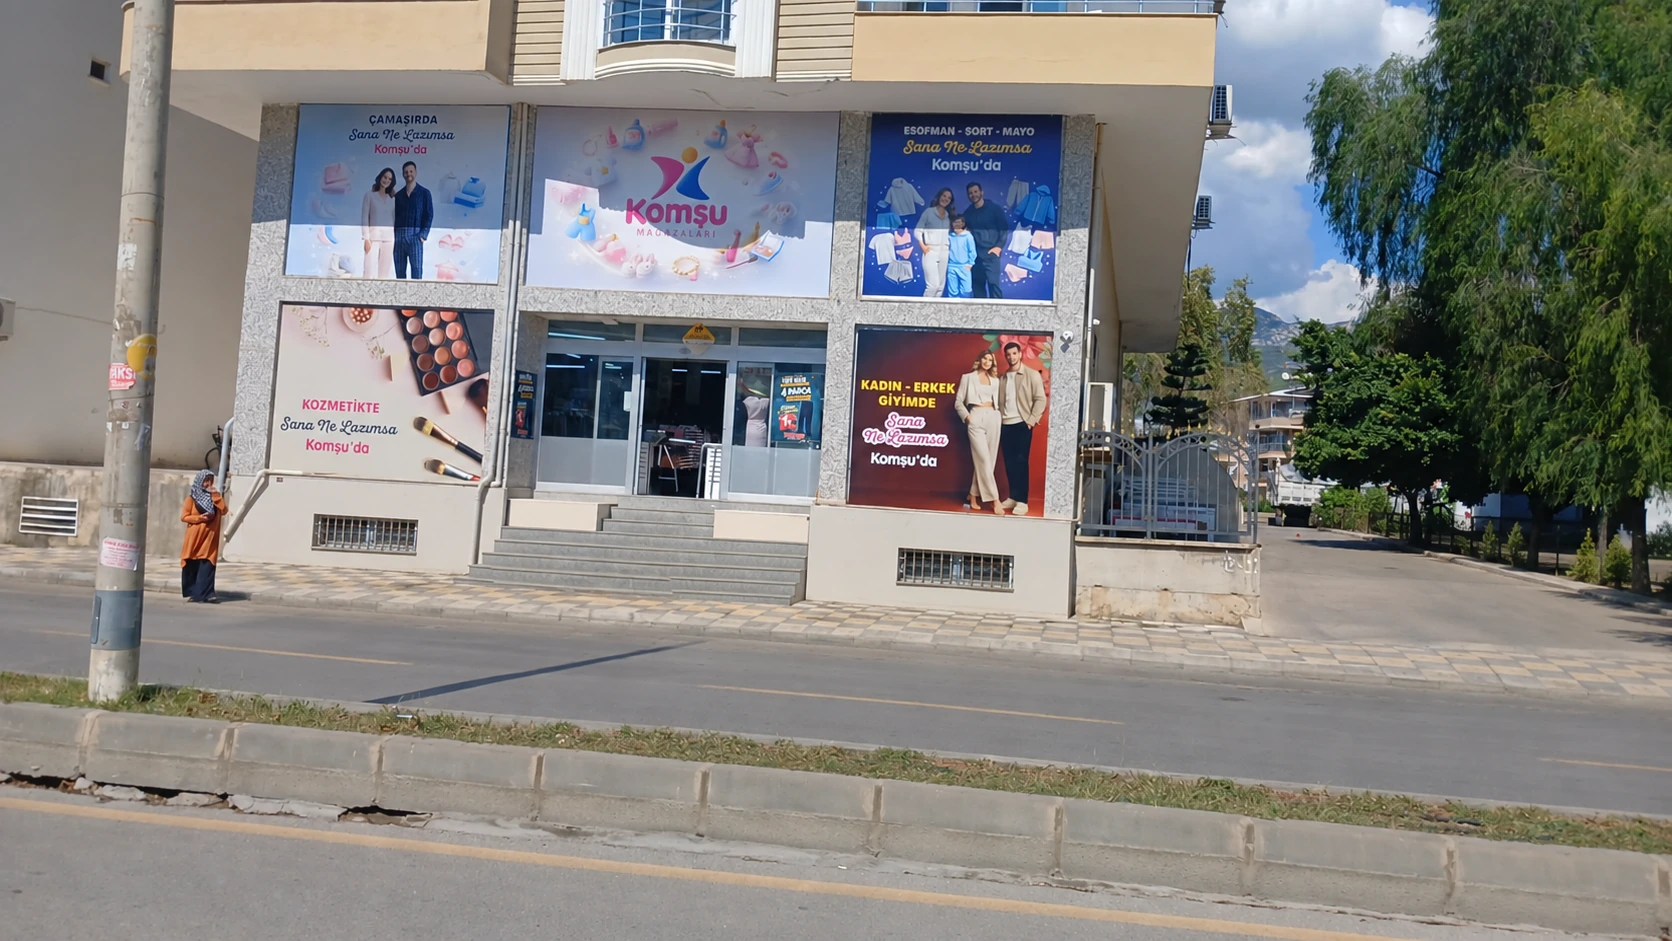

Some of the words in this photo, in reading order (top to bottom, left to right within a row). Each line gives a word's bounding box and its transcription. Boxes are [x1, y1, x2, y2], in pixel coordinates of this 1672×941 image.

[369, 115, 438, 126] ÇAMAŞIRDA
[348, 128, 380, 141] Sana
[382, 129, 401, 141] Ne
[403, 129, 455, 142] Lazımsa
[1002, 127, 1035, 136] MAYO
[374, 144, 427, 156] Komşu'da
[903, 139, 942, 154] Sana
[944, 141, 967, 155] Ne
[968, 140, 1032, 156] Lazımsa
[931, 158, 1002, 174] Komşu'da
[625, 198, 728, 229] Komşu
[861, 380, 902, 391] KADIN
[913, 382, 956, 394] ERKEK
[302, 399, 380, 413] KOZMETİKTE
[878, 393, 936, 408] GİYİMDE
[280, 416, 315, 431] Sana
[317, 419, 337, 434] Ne
[340, 420, 398, 435] Lazımsa
[885, 412, 925, 428] Sana
[864, 429, 885, 443] Ne
[887, 429, 947, 446] Lazımsa
[306, 438, 370, 455] Komşu'da
[870, 452, 938, 468] Komşu'da
